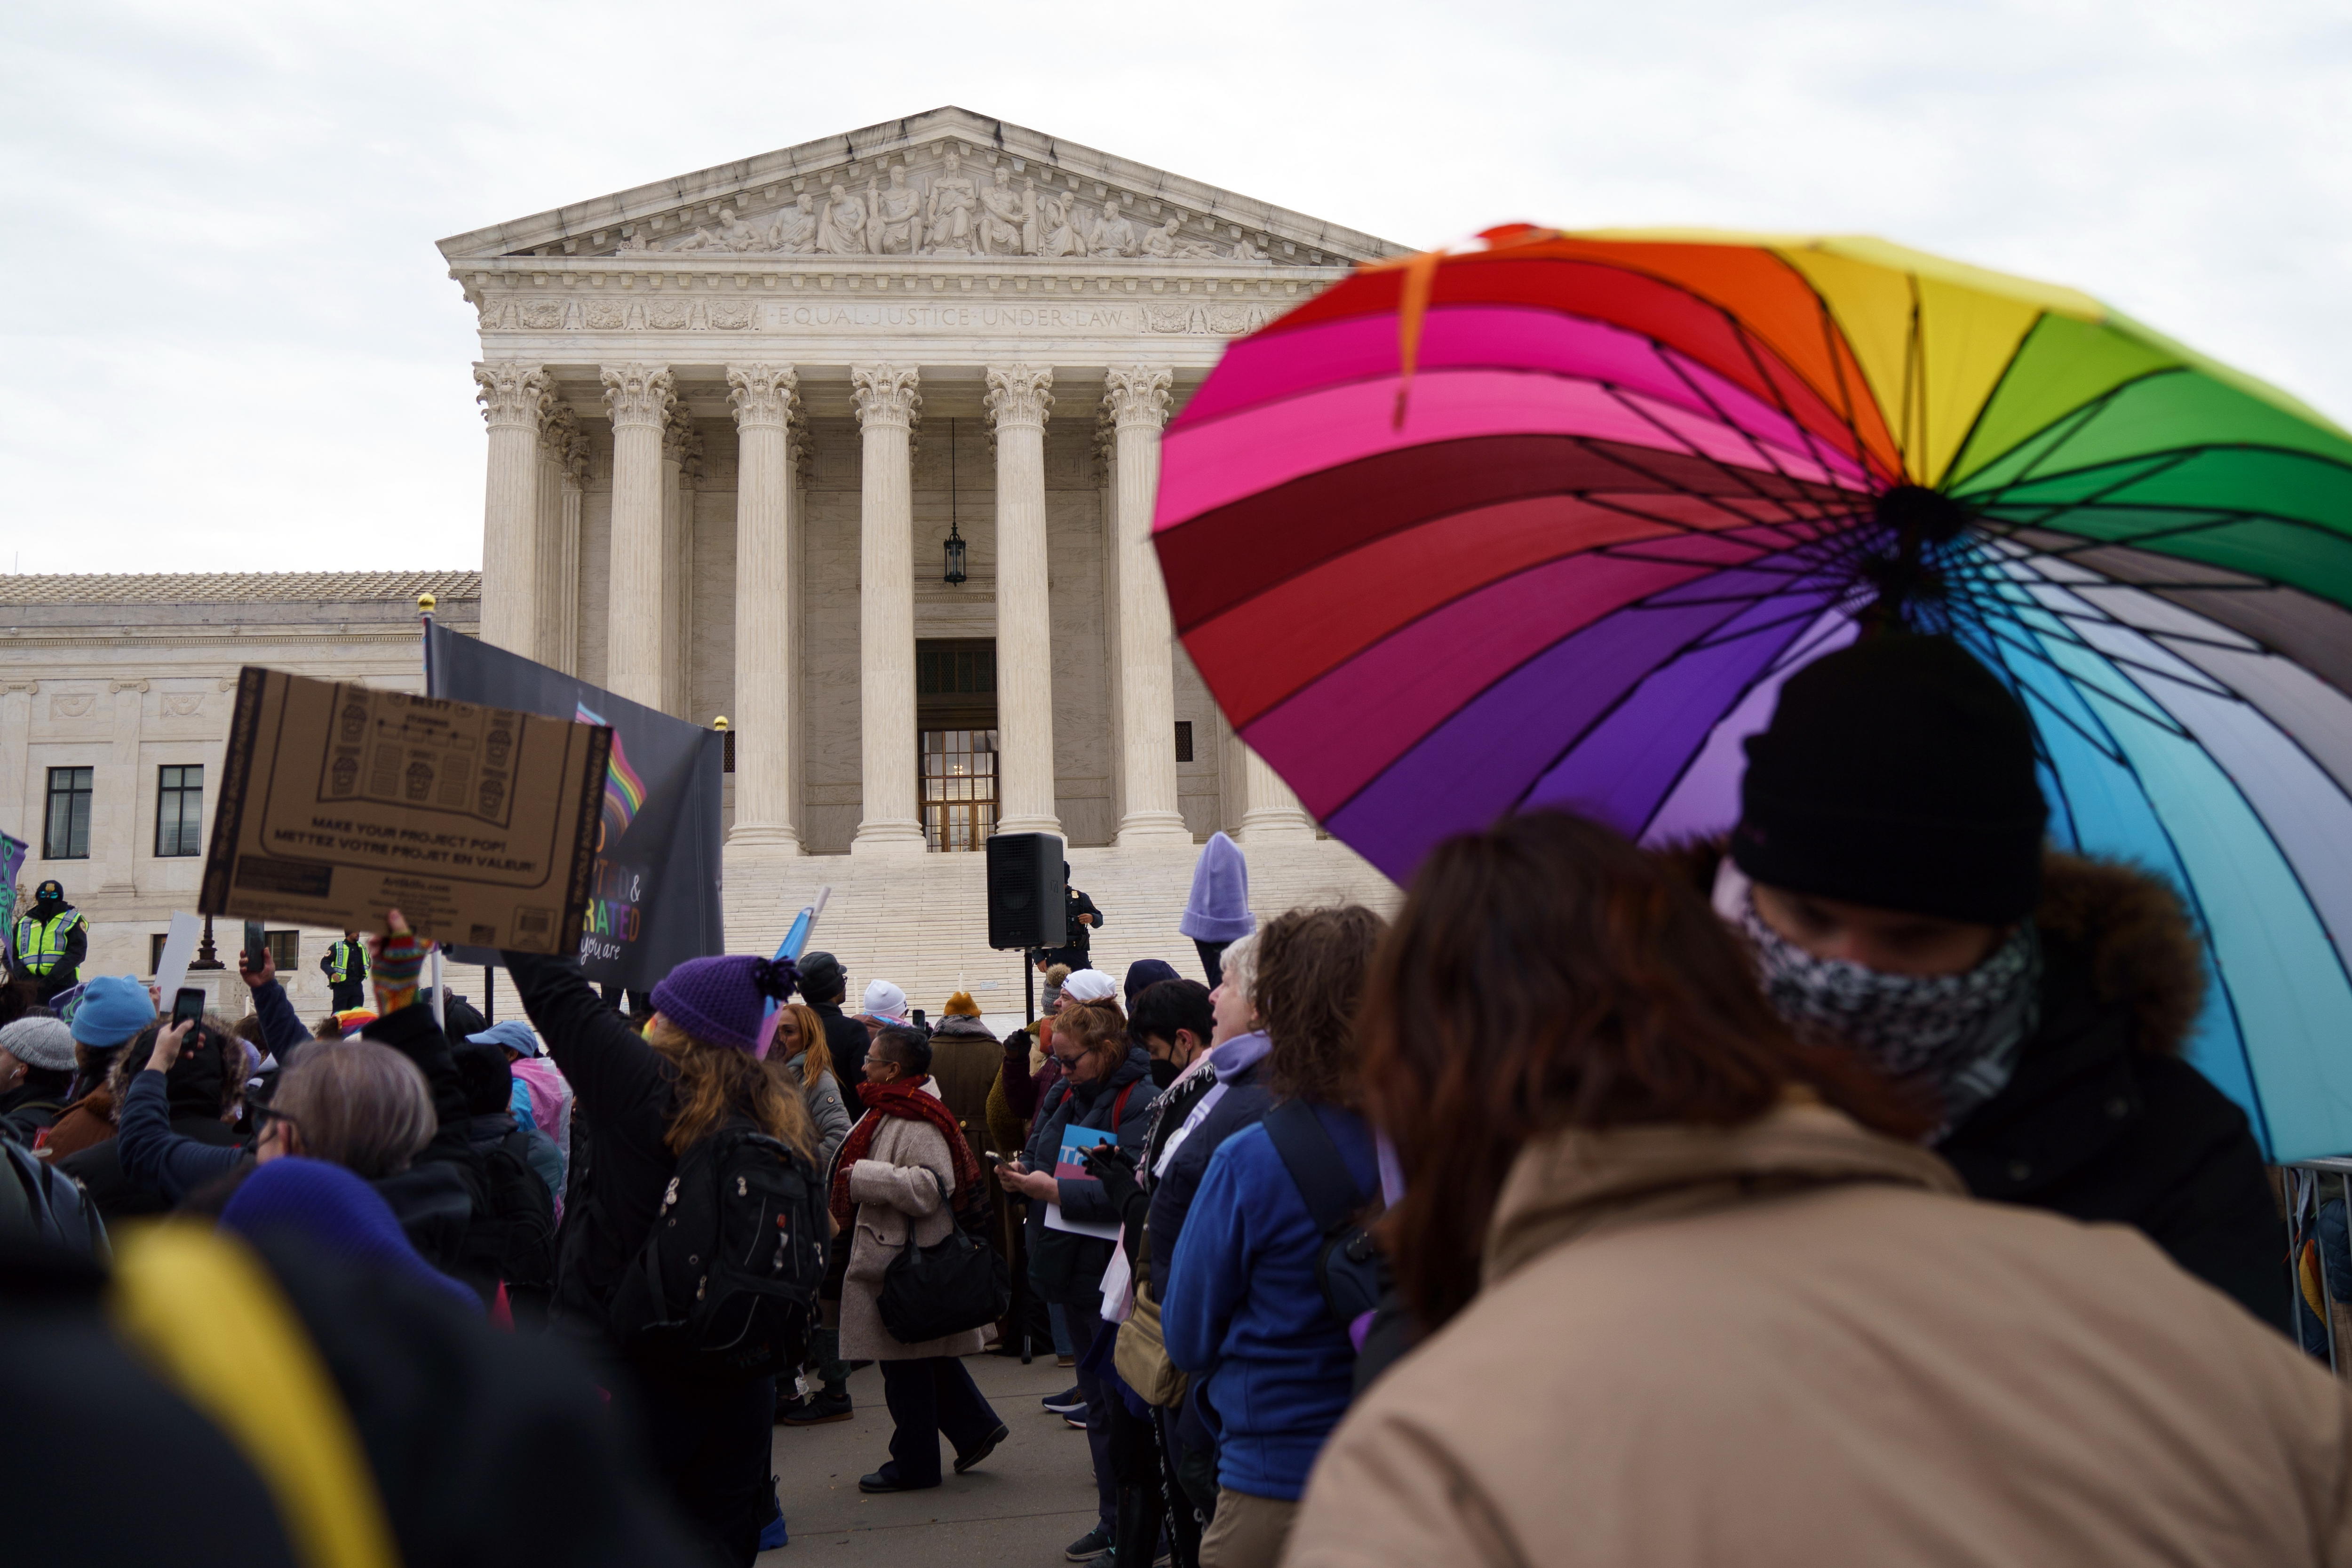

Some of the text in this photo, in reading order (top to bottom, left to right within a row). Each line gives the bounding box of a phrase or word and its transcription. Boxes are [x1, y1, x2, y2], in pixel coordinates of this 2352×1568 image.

[779, 307, 1122, 326] EQUAL JUSTICE UNDER LAW
[275, 829, 536, 874] METTEZ VOTRE PROJET EN VALEUR!
[312, 818, 506, 853] MAKE YOUR PROJECT POP!
[593, 859, 640, 902] TED &
[580, 937, 620, 965] you are
